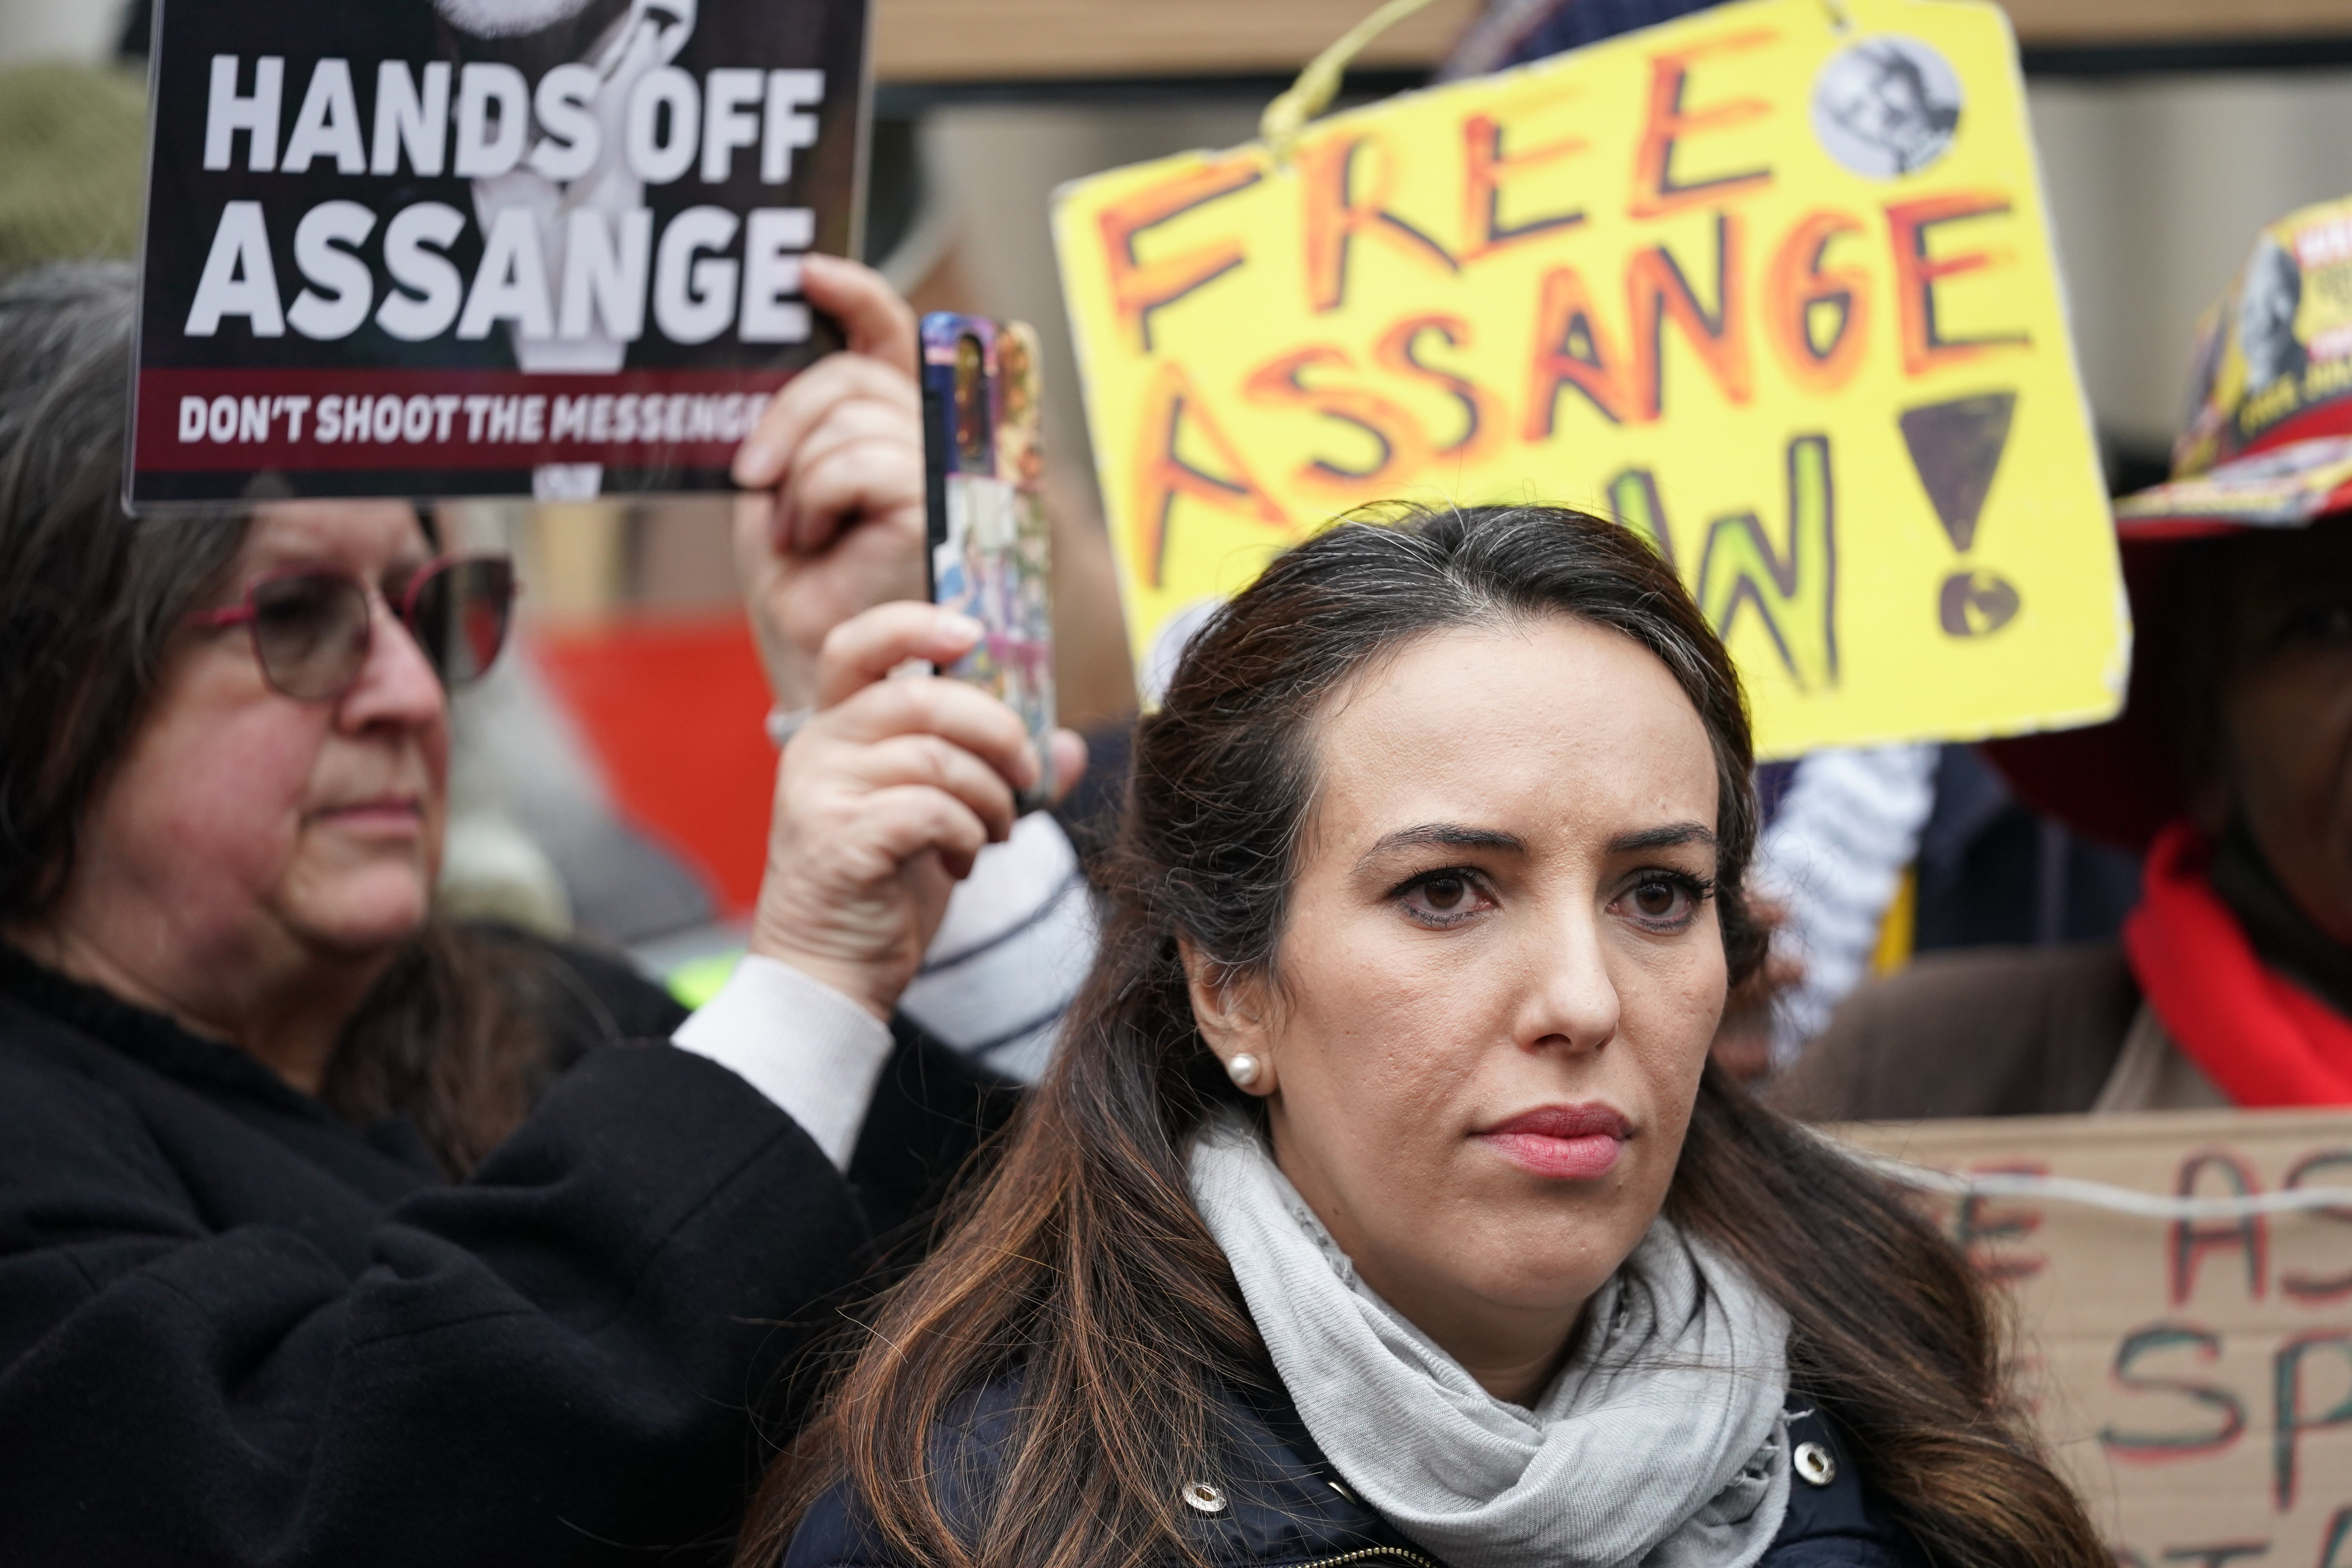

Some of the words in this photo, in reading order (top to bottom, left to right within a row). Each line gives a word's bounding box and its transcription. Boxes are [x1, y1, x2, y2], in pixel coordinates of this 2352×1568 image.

[203, 54, 601, 181] HANDS
[625, 65, 826, 185] OFF
[1095, 27, 1783, 356] FREE
[183, 199, 817, 345] ASSANGE
[178, 395, 310, 443] DON'T
[315, 395, 462, 443] SHOOT
[464, 395, 546, 443] THE
[1134, 188, 2035, 591] ASSANGE
